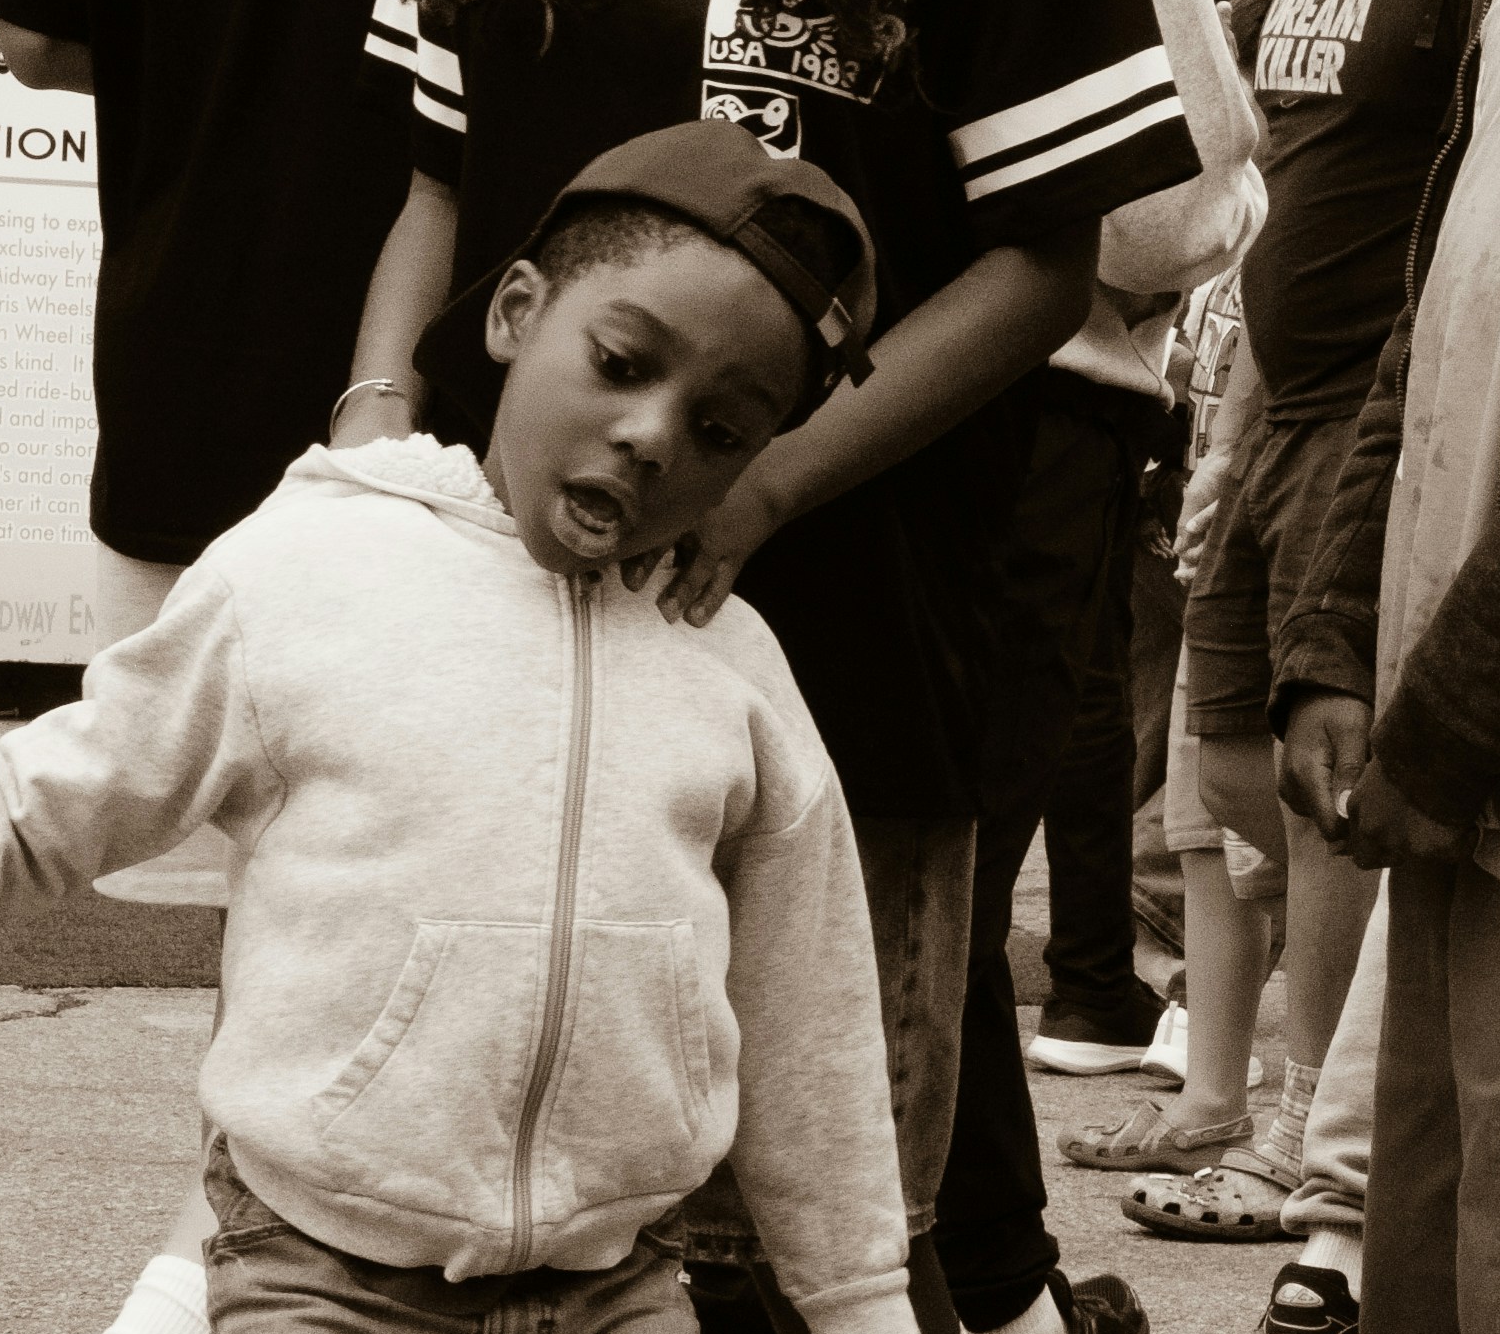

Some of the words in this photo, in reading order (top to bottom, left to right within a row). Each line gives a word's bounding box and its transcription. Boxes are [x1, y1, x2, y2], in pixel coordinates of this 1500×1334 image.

[710, 37, 767, 68] USA
[1253, 36, 1344, 95] KILLER
[42, 213, 61, 231] to
[14, 323, 73, 344] Wheel
[14, 351, 58, 372] kind.
[73, 355, 84, 372] It
[8, 408, 46, 429] and
[16, 441, 49, 457] our
[17, 465, 54, 486] and
[29, 495, 42, 512] it
[46, 499, 80, 514] can
[18, 526, 55, 542] one
